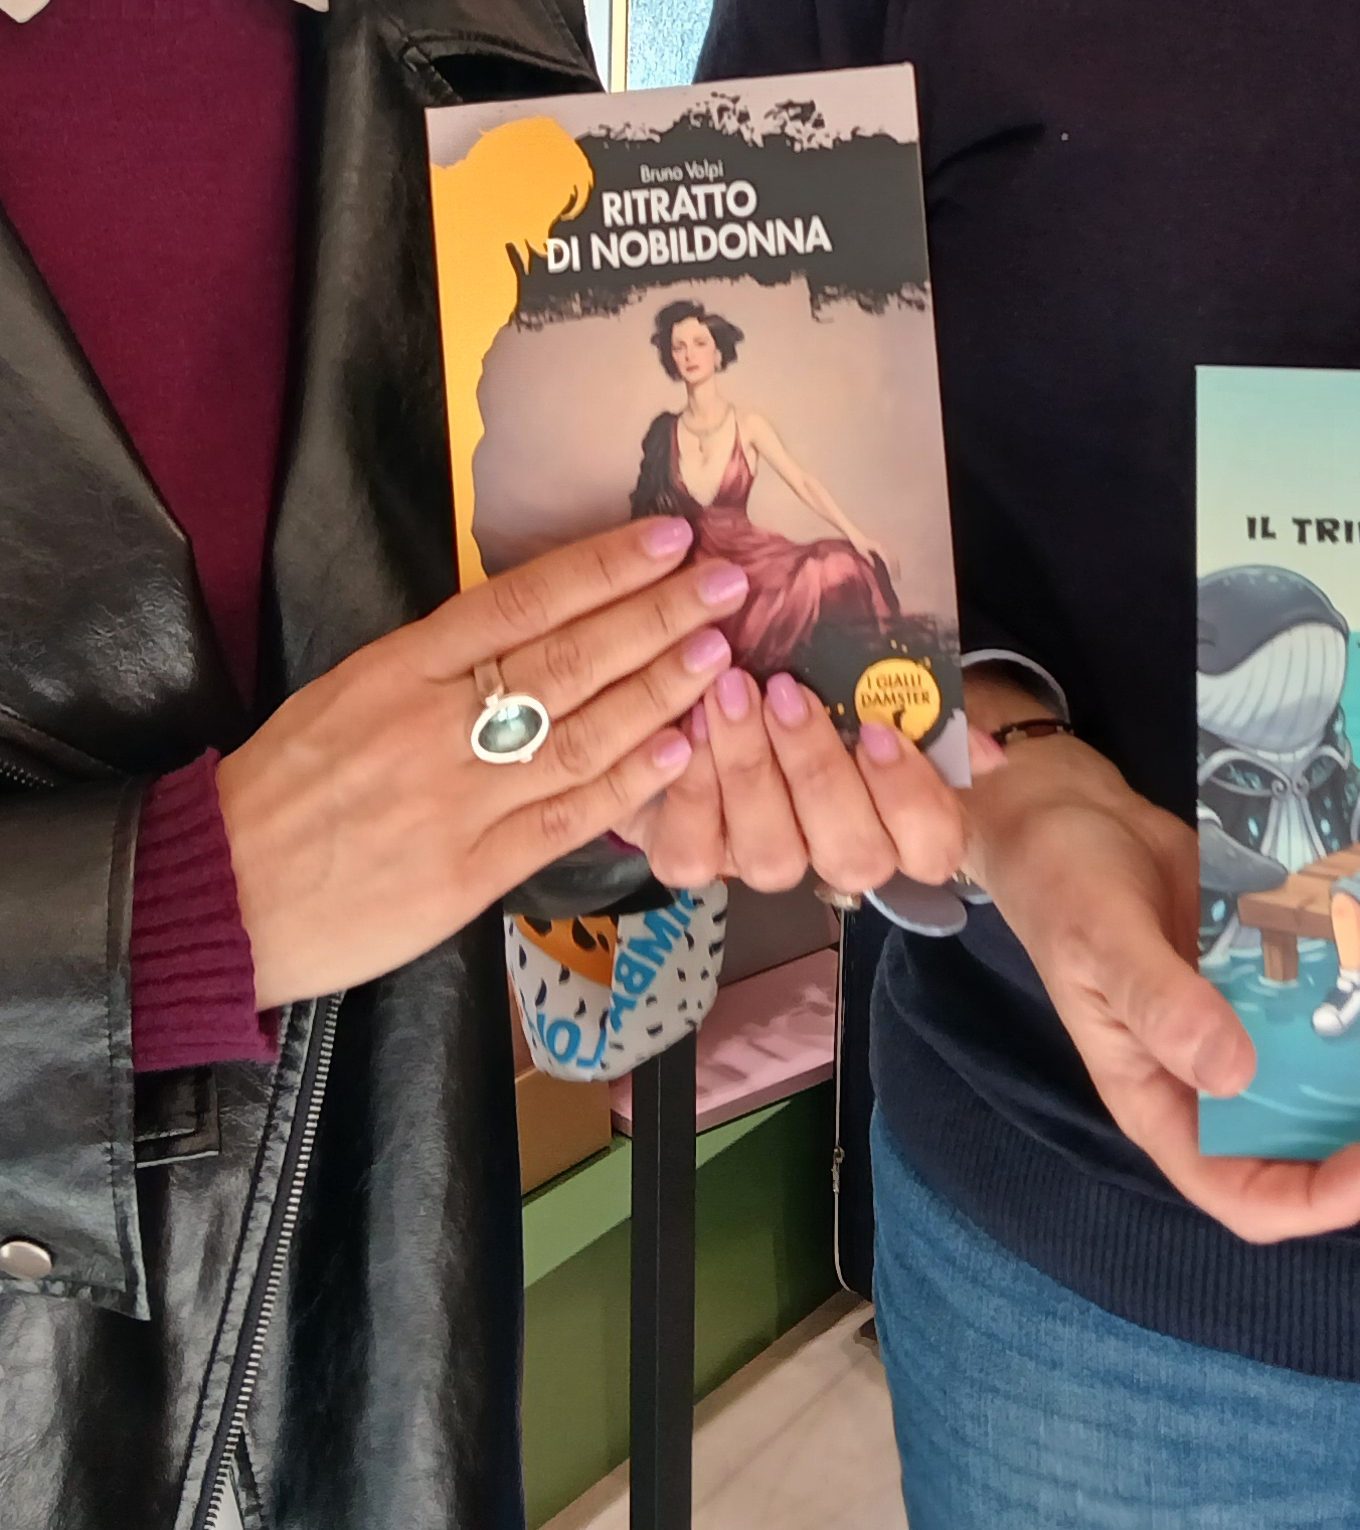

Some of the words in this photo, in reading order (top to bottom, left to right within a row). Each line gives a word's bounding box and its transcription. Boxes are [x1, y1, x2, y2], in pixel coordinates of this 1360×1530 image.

[640, 163, 683, 185] Bruno
[685, 159, 724, 181] Volpi
[602, 181, 757, 227] RITRATTO
[546, 238, 580, 273] DI
[591, 215, 832, 270] NOBILDONNA
[1245, 515, 1276, 541] IL
[876, 673, 921, 688] GIALLI
[861, 691, 930, 707] DAMSTER
